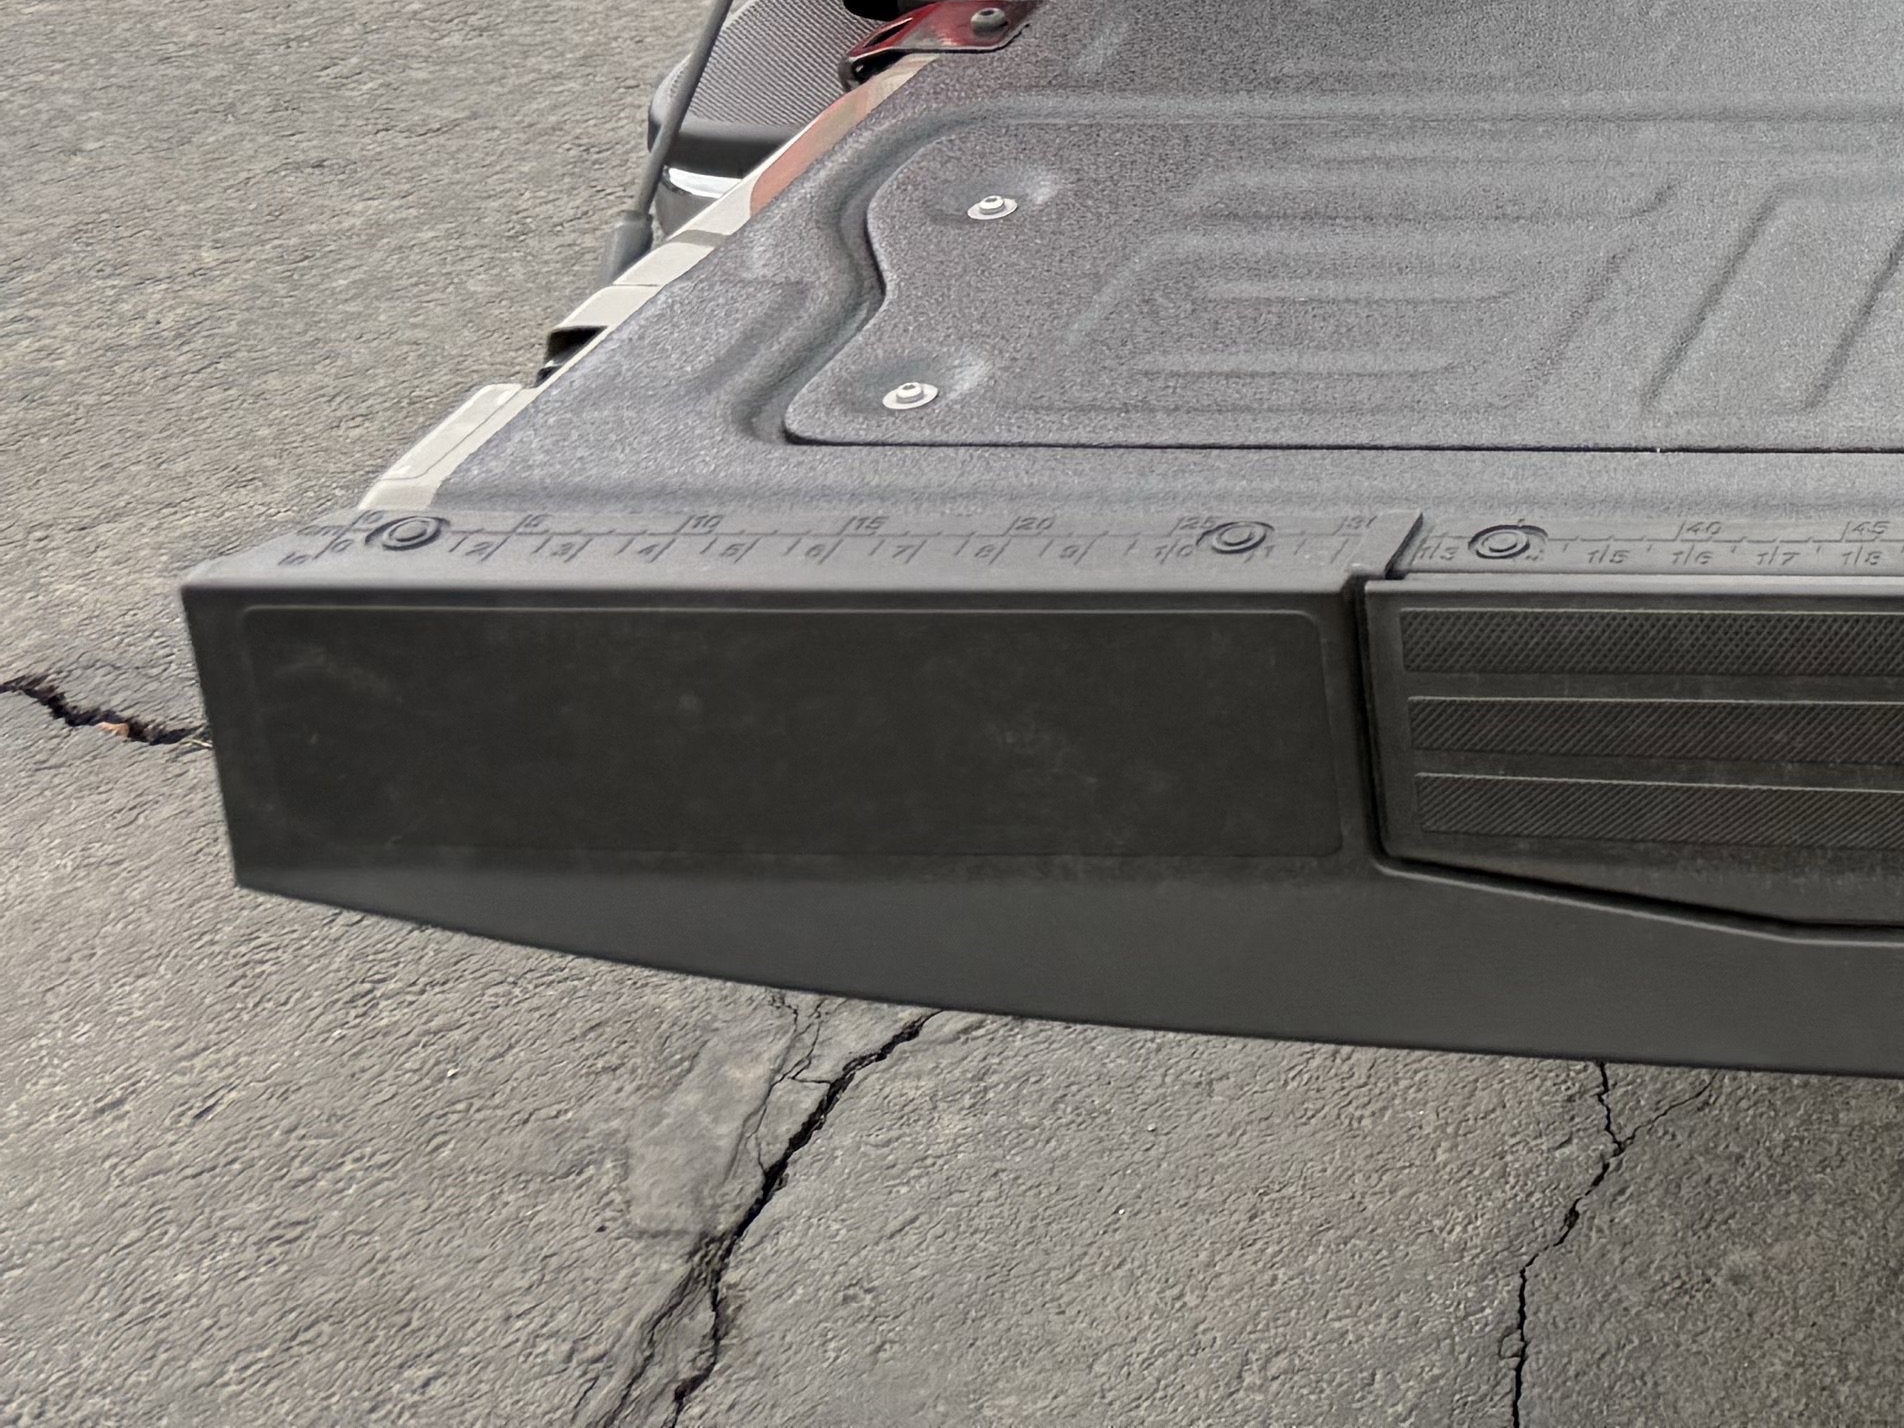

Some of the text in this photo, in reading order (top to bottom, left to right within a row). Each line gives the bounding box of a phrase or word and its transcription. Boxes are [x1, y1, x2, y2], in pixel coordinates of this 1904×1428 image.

[854, 515, 889, 531] 15
[1014, 516, 1055, 531] 20
[1686, 520, 1721, 535] 40
[1852, 520, 1891, 535] 45
